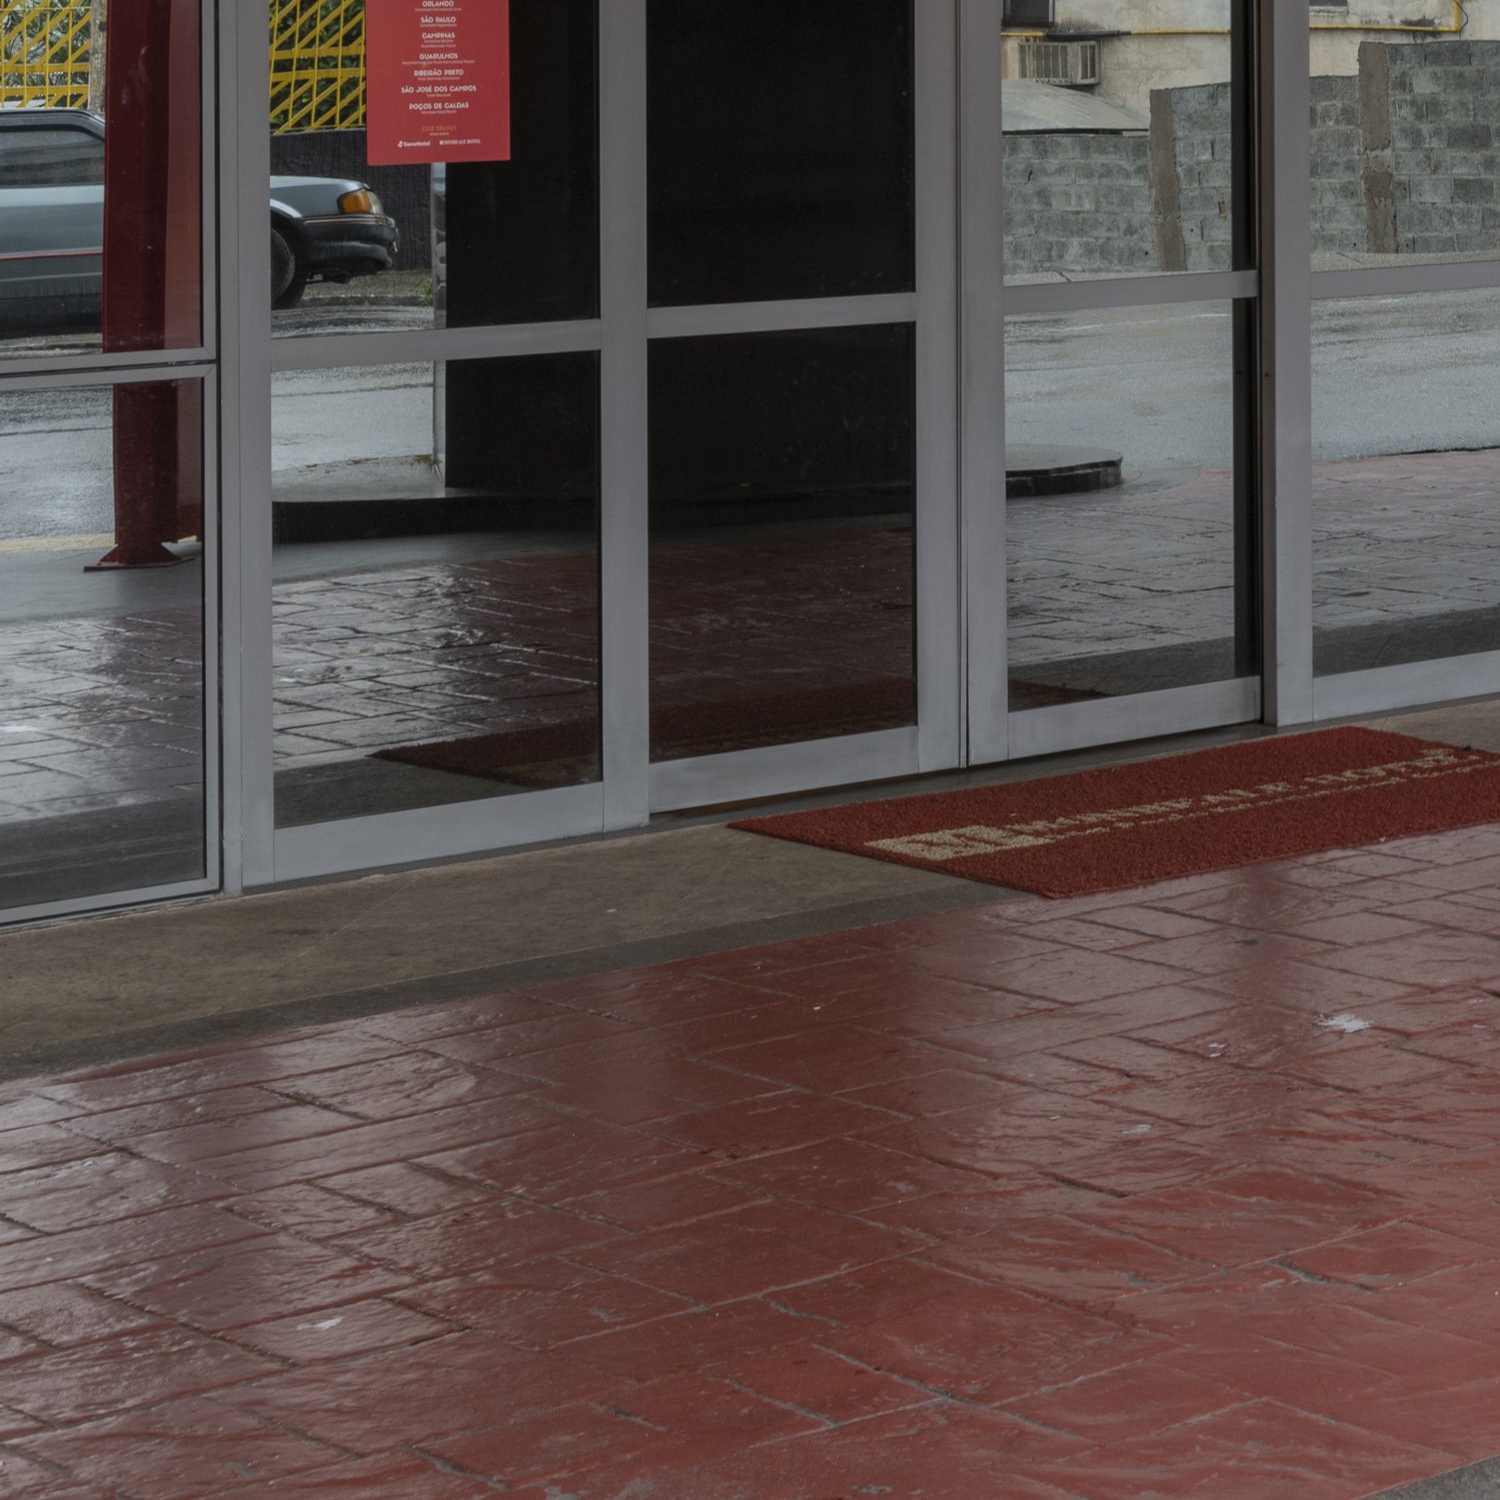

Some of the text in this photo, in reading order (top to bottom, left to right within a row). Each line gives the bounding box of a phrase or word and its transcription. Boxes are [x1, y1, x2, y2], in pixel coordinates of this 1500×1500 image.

[422, 0, 454, 8] ORLANDO
[415, 85, 433, 93] JOSÉ
[434, 85, 448, 93] DOS
